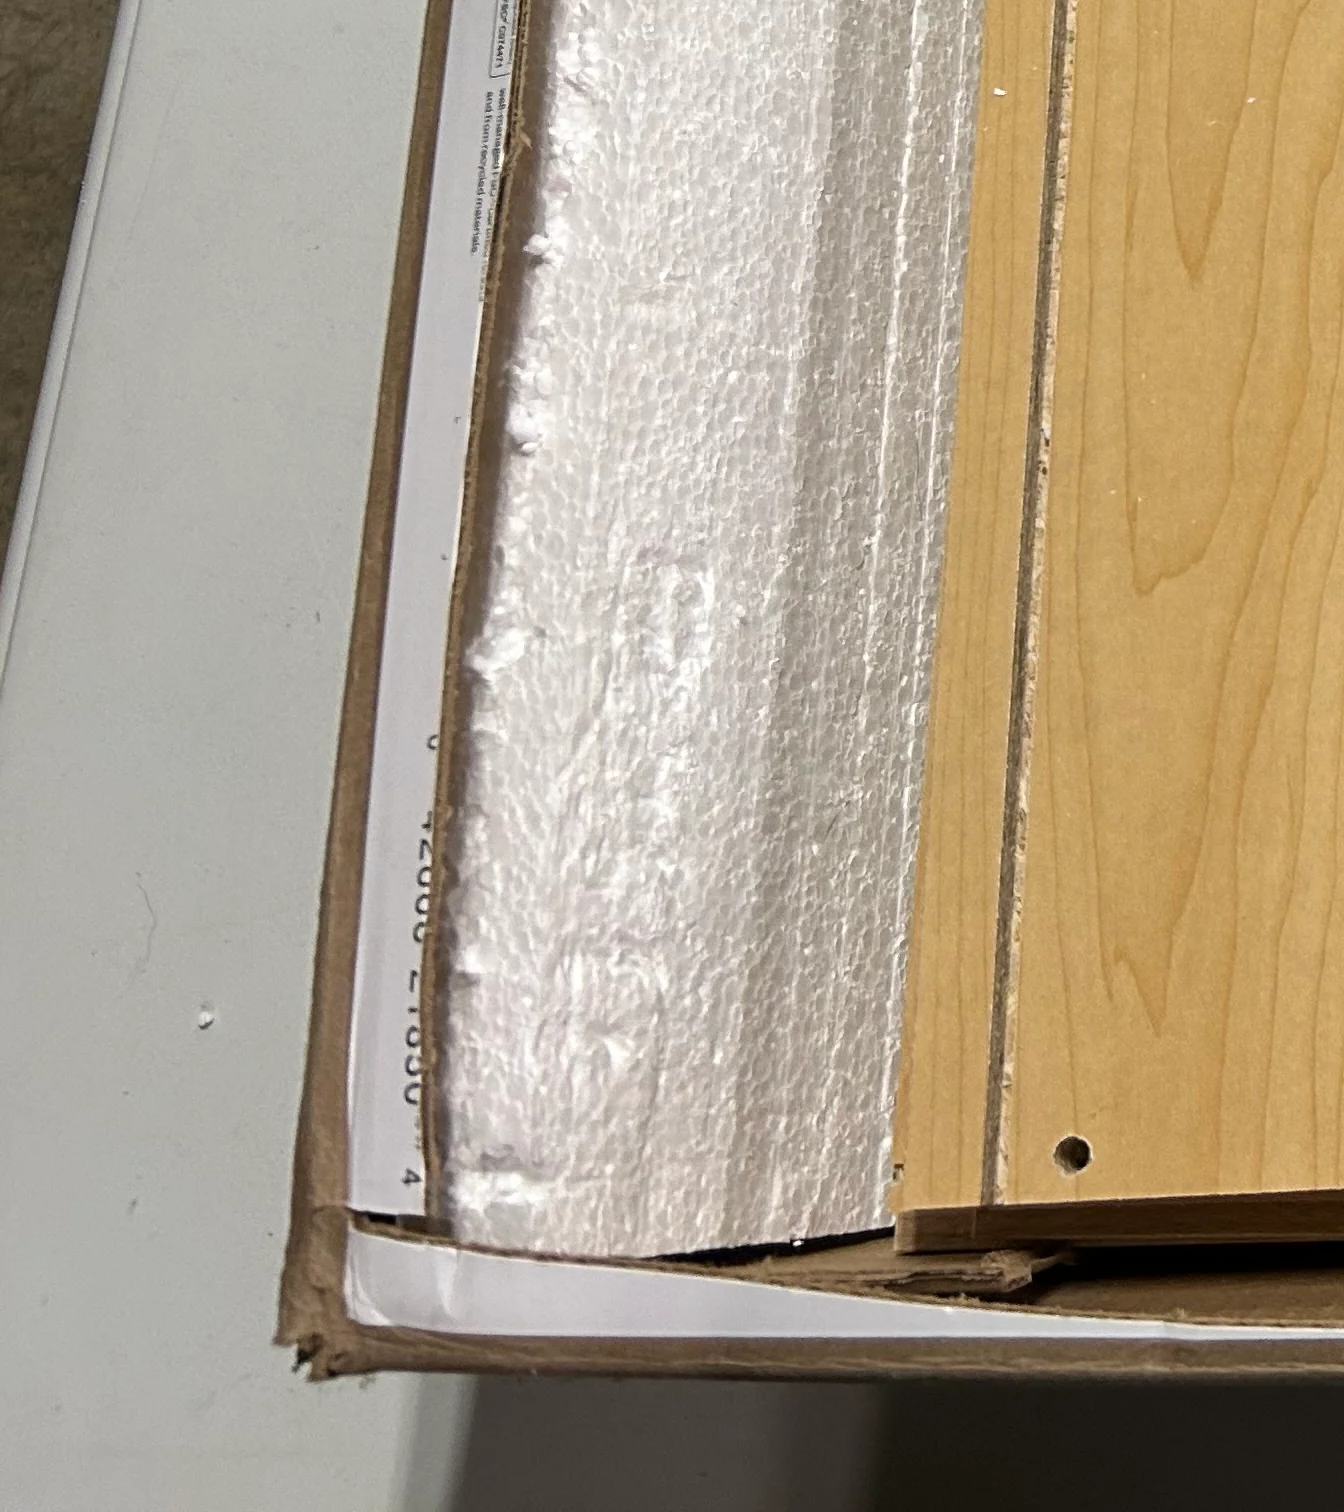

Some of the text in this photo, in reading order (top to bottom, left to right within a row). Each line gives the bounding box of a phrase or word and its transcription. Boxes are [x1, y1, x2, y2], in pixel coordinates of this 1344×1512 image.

[484, 91, 494, 113] and
[481, 114, 492, 143] from
[476, 144, 488, 194] recycled
[402, 1168, 422, 1185] 4
